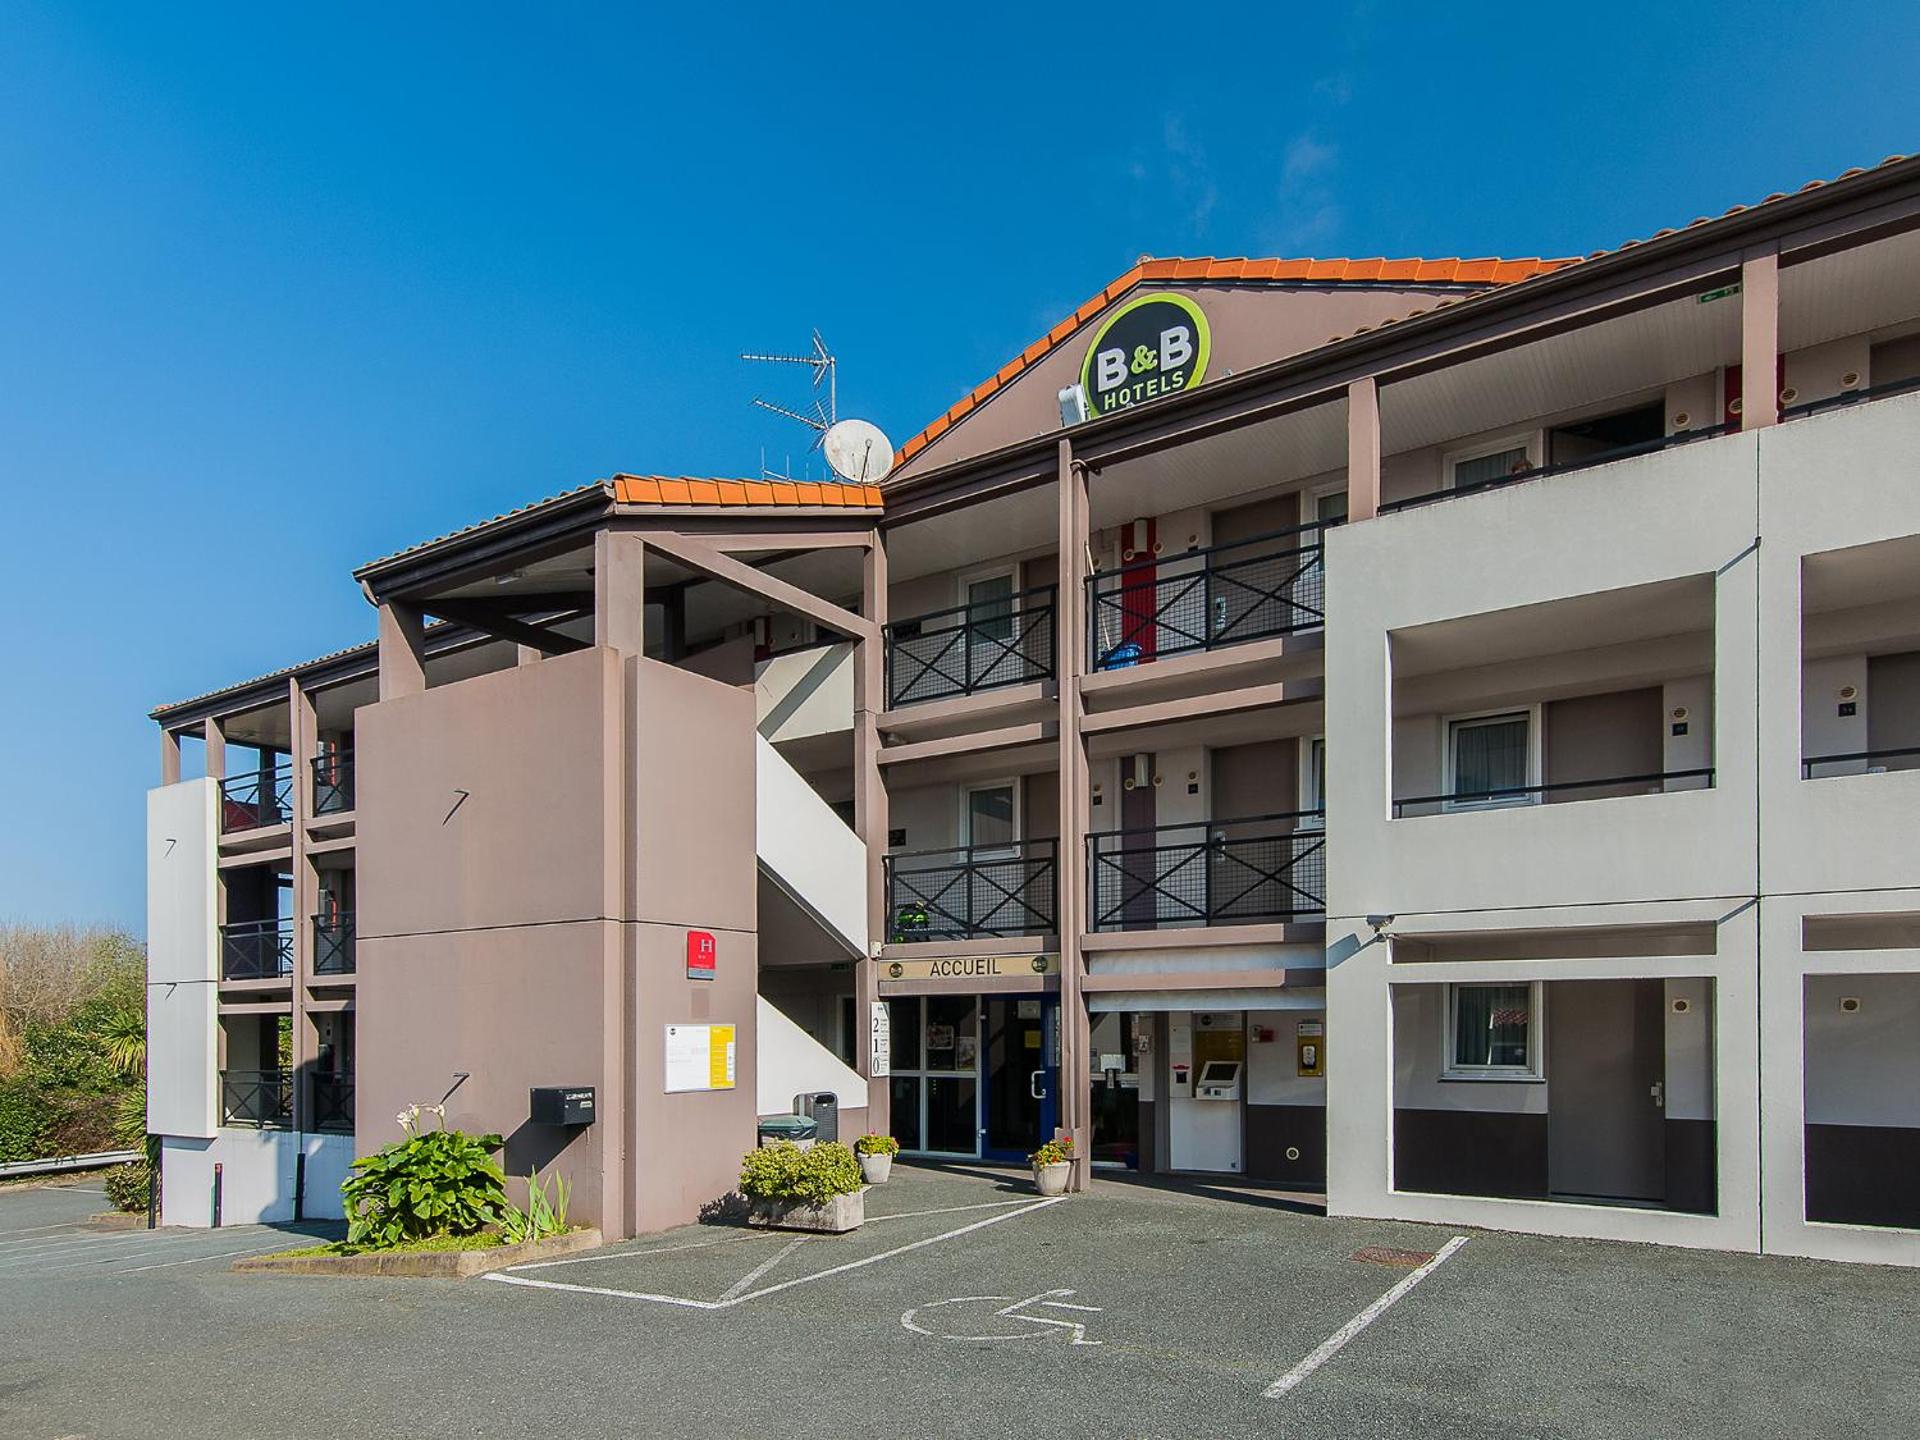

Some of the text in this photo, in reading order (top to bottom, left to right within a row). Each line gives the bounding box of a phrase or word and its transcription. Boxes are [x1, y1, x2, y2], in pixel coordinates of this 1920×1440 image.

[1097, 325, 1193, 392] B&B
[1104, 370, 1184, 410] HOTELS
[701, 939, 713, 953] H
[930, 959, 1002, 976] ACCUEIL
